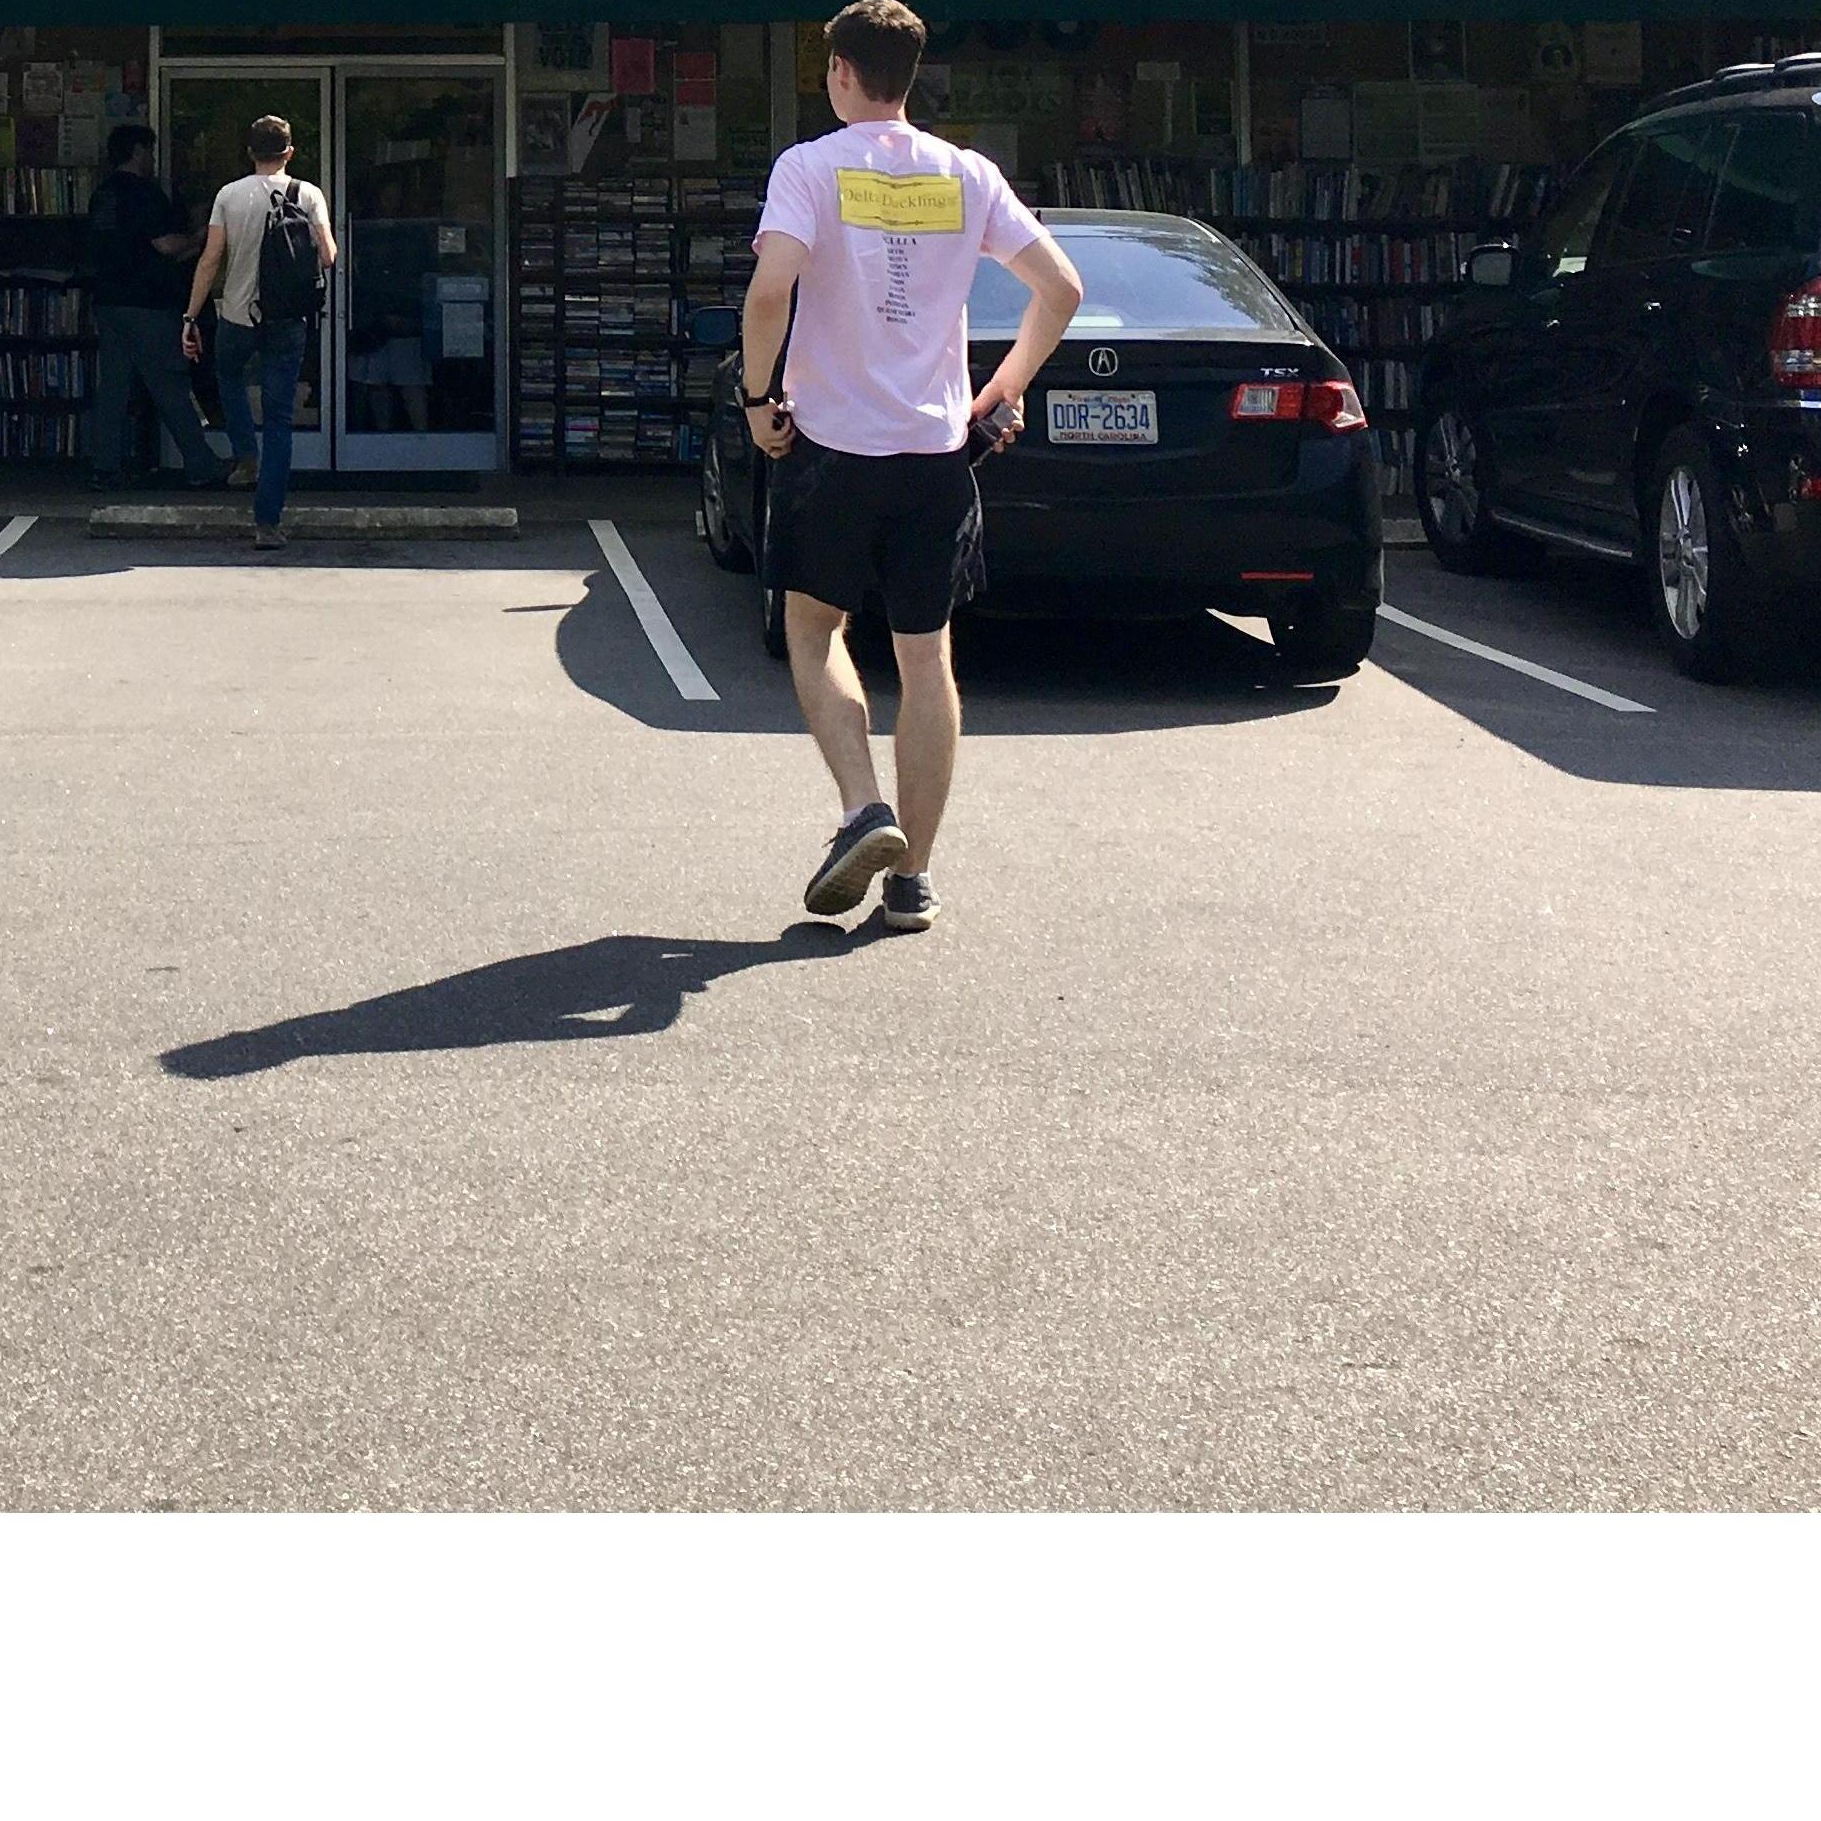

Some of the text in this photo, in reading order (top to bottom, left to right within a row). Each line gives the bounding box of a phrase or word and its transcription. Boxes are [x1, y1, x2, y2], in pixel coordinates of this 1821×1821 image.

[1261, 367, 1299, 378] TSX
[1053, 403, 1150, 429] DDR-2634
[1060, 432, 1147, 441] NORTH CAROLINA
